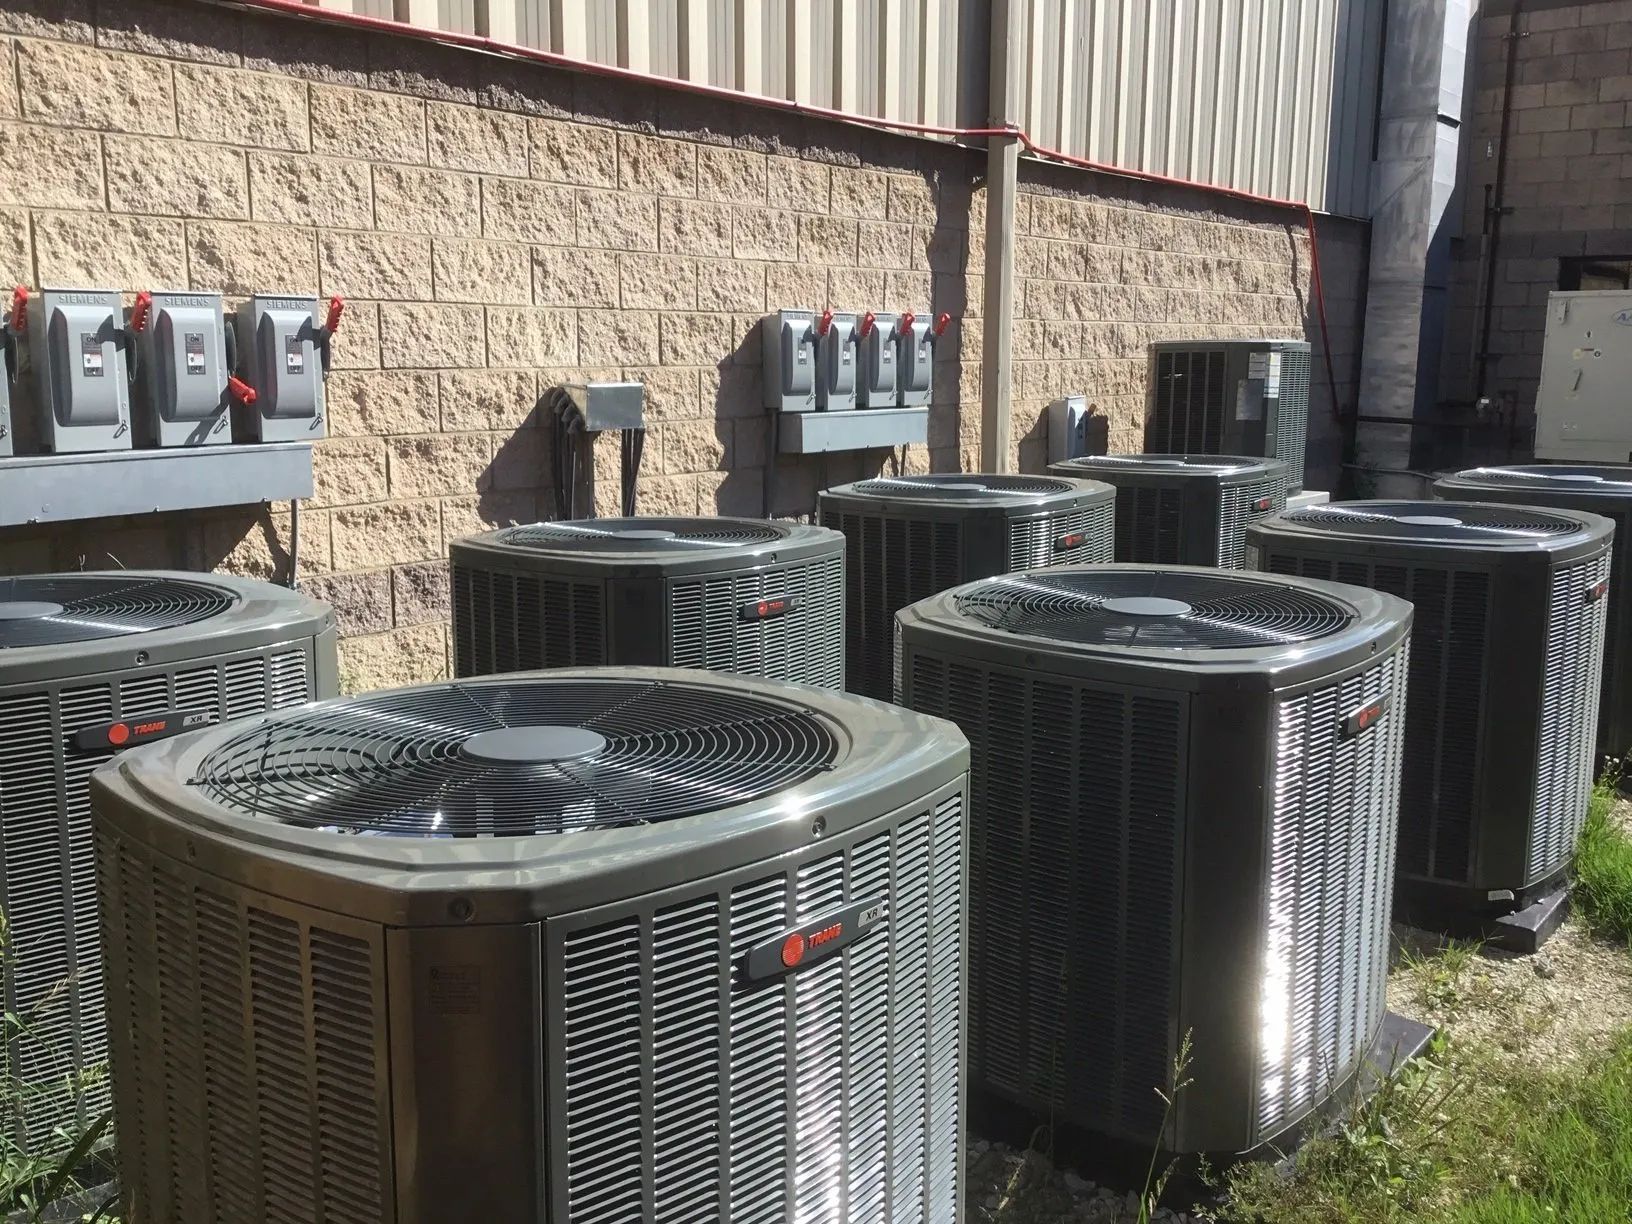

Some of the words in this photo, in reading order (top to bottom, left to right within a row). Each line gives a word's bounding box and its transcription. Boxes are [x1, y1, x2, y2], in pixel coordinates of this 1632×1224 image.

[58, 295, 108, 305] SIEMENS
[164, 297, 210, 307] SIEMENS
[266, 300, 307, 310] SIEMENS
[190, 365, 203, 373] OFF
[190, 715, 203, 723] XR
[866, 908, 878, 921] XR
